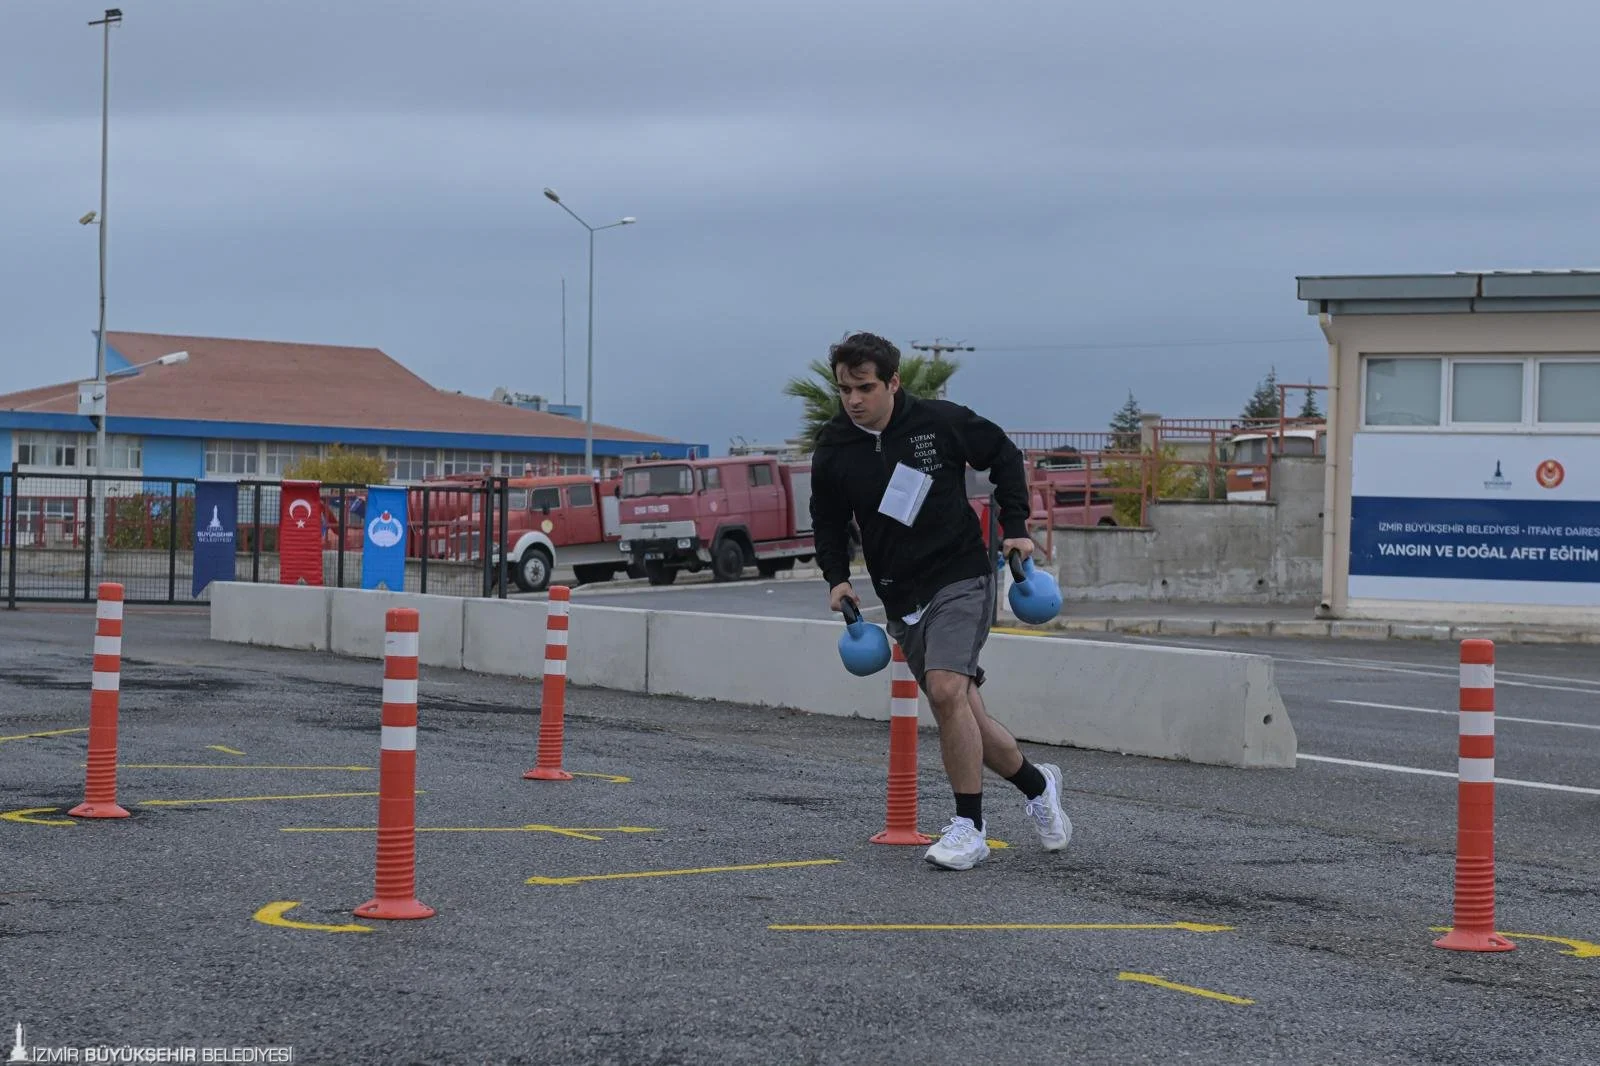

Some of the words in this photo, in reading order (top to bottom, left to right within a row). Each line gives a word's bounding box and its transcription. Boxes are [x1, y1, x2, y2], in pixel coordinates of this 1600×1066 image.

[915, 441, 934, 450] ADDS
[914, 448, 937, 458] COLOR
[921, 457, 933, 465] TO
[1379, 521, 1403, 532] İZMİR
[1405, 522, 1465, 534] BÜYÜKŞEHİR
[1466, 524, 1520, 535] BELEDİYESİ
[1527, 525, 1563, 536] İTFAİYE
[1378, 543, 1431, 557] YANGIN
[1435, 544, 1454, 557] VE
[1457, 543, 1507, 559] DOĞAL
[1510, 546, 1546, 560] AFET
[1549, 545, 1599, 561] EĞİTİM
